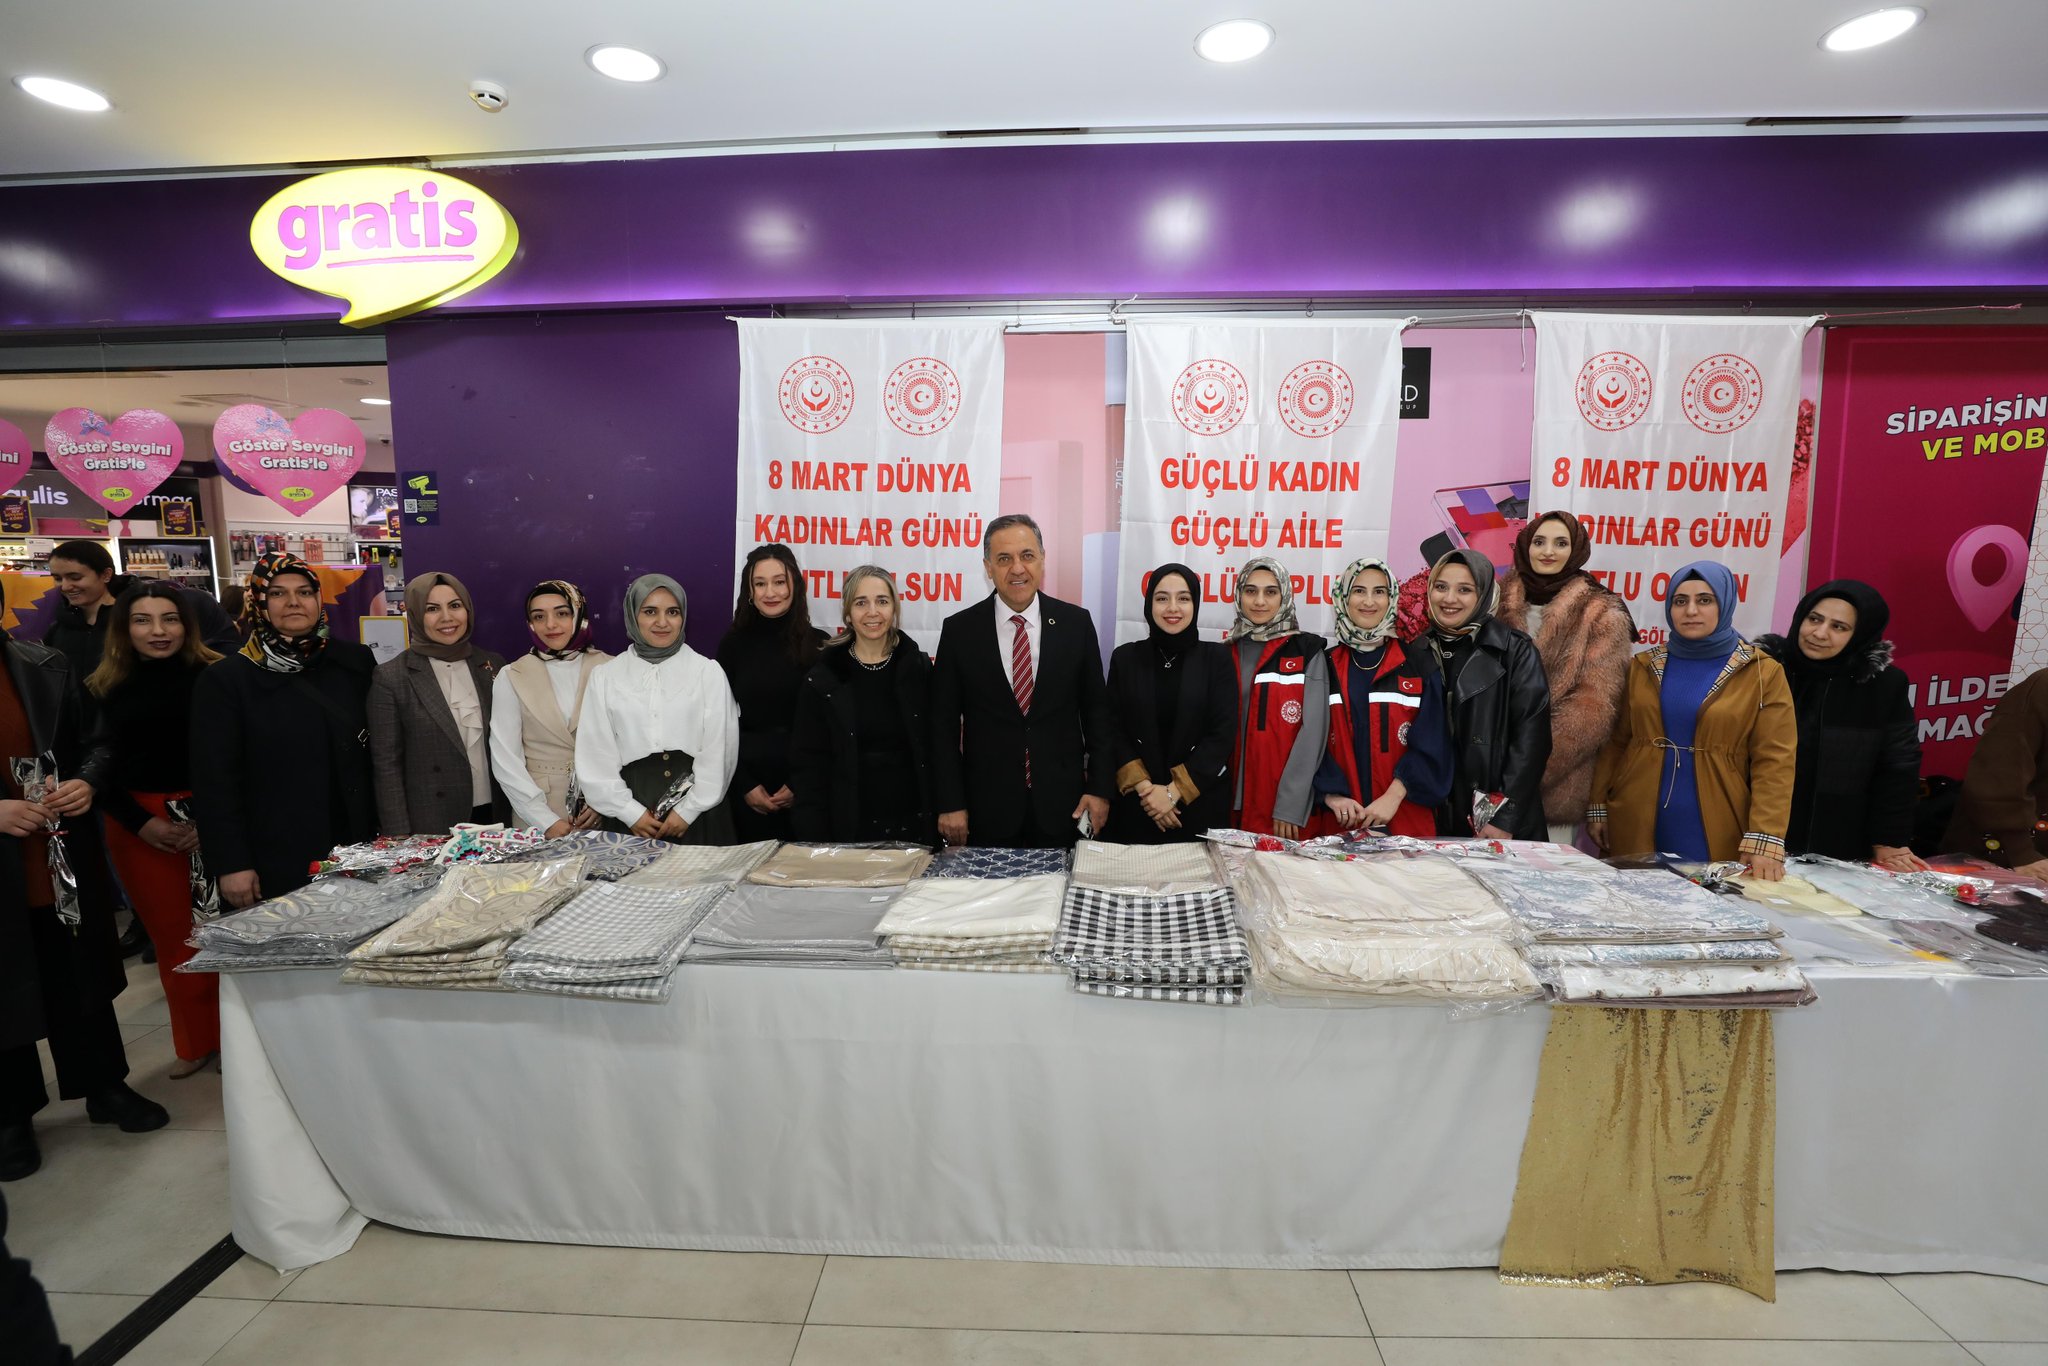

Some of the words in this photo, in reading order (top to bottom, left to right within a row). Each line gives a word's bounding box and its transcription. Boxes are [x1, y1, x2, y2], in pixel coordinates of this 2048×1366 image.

[277, 181, 478, 271] gratis
[1885, 393, 2048, 435] SİPARİŞİN
[0, 450, 19, 464] ni
[58, 440, 108, 456] Göster
[111, 441, 172, 456] Sevgini
[229, 439, 287, 453] Göster
[291, 439, 354, 457] Sevgini
[1921, 436, 1964, 461] VE
[1973, 427, 2046, 456] MOB
[83, 458, 146, 470] Gratis'le
[259, 456, 329, 471] Gratis'le
[768, 459, 783, 490] 8
[791, 460, 869, 491] MART
[876, 457, 972, 493] DÜNYA
[1160, 452, 1260, 499] GÜÇLÜ
[1267, 461, 1361, 492] KADIN
[1551, 456, 1572, 488] 8
[1580, 457, 1661, 492] MART
[1667, 455, 1768, 493] DÜNYA
[754, 513, 893, 547] KADINLAR
[901, 511, 982, 548] GÜNÜ
[1170, 510, 1269, 555] GÜÇLÜ
[1277, 511, 1344, 549] AİLE
[1689, 511, 1773, 548] GÜNÜ
[1927, 674, 2010, 706] İLDE
